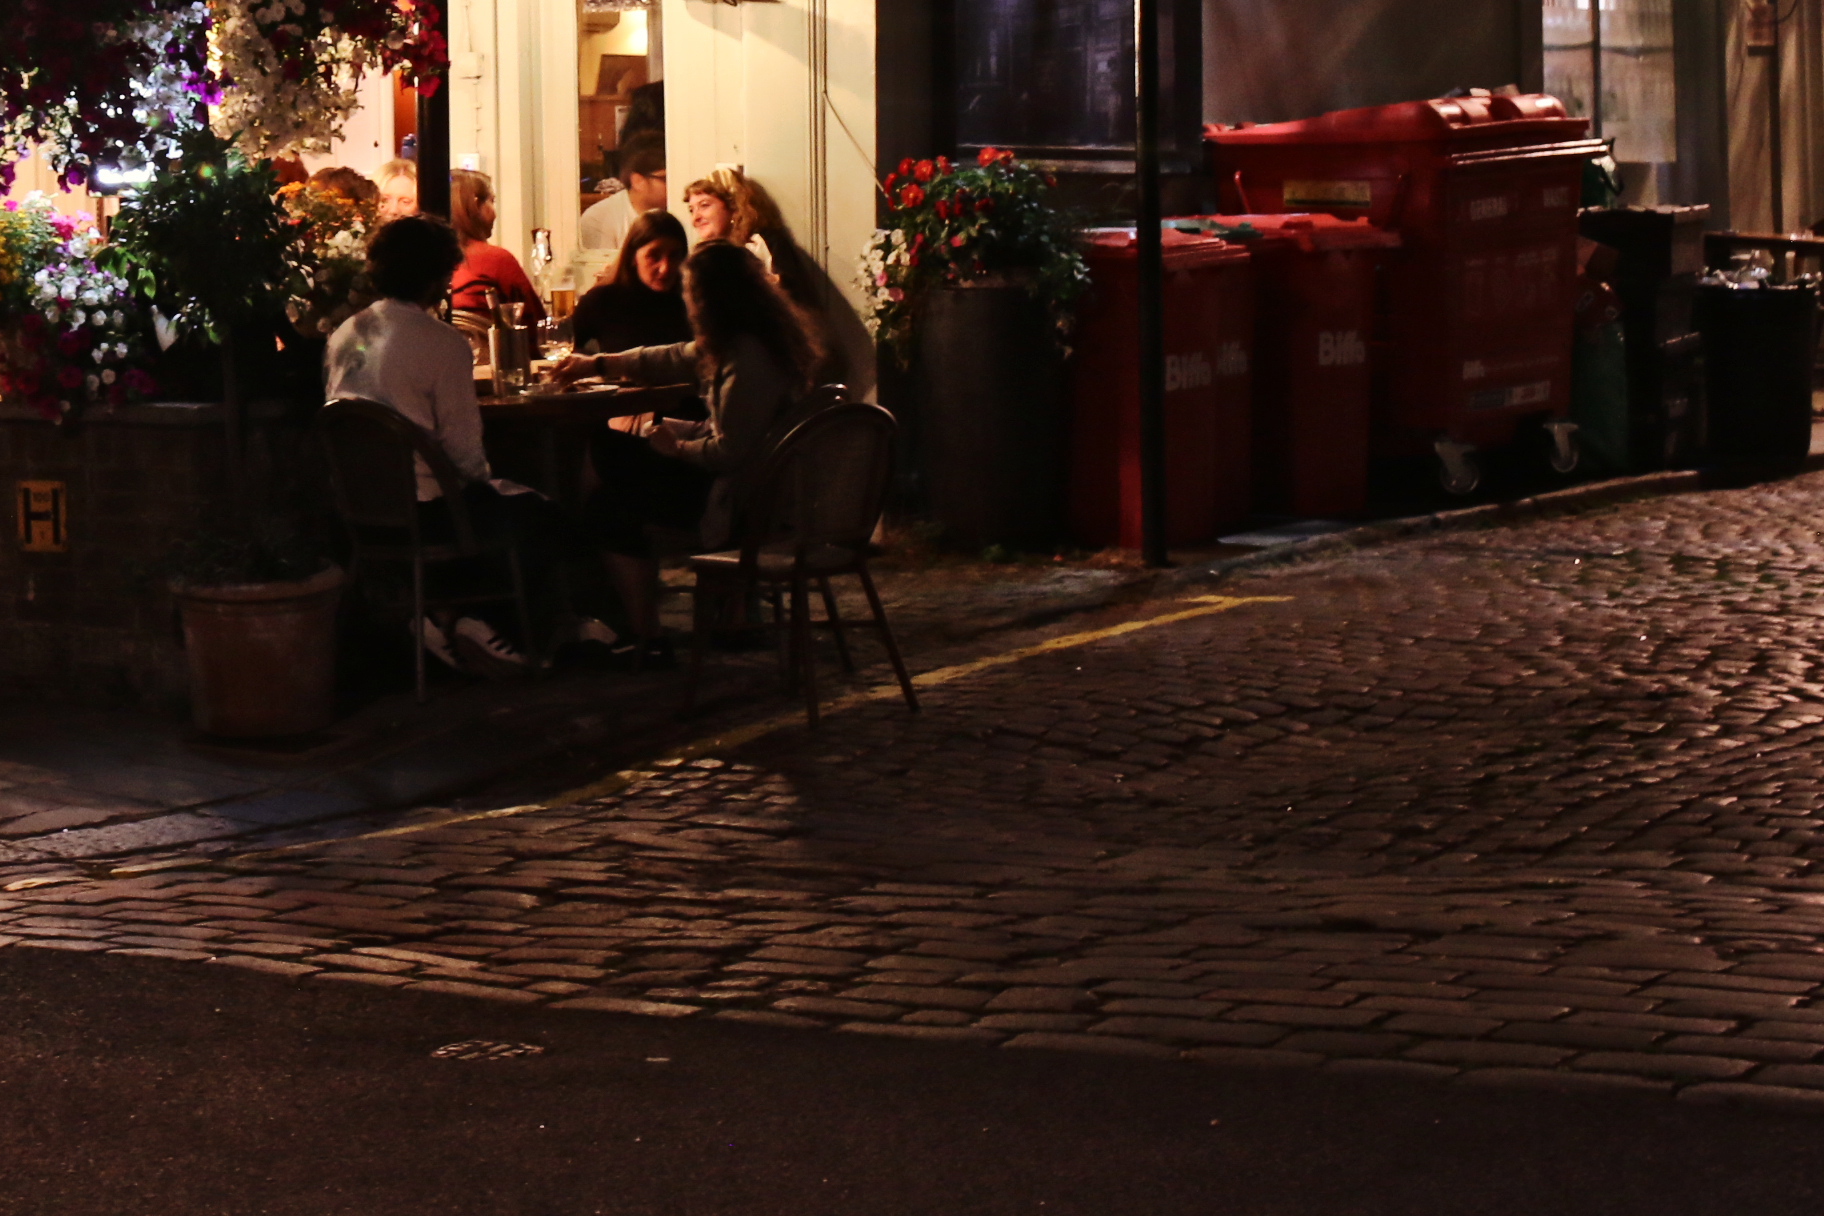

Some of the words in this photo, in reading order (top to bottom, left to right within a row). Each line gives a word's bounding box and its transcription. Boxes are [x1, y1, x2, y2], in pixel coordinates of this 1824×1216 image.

[1216, 340, 1248, 376] iffa
[1318, 330, 1366, 367] Biffa
[1164, 351, 1212, 392] Biffa
[23, 487, 61, 545] H
